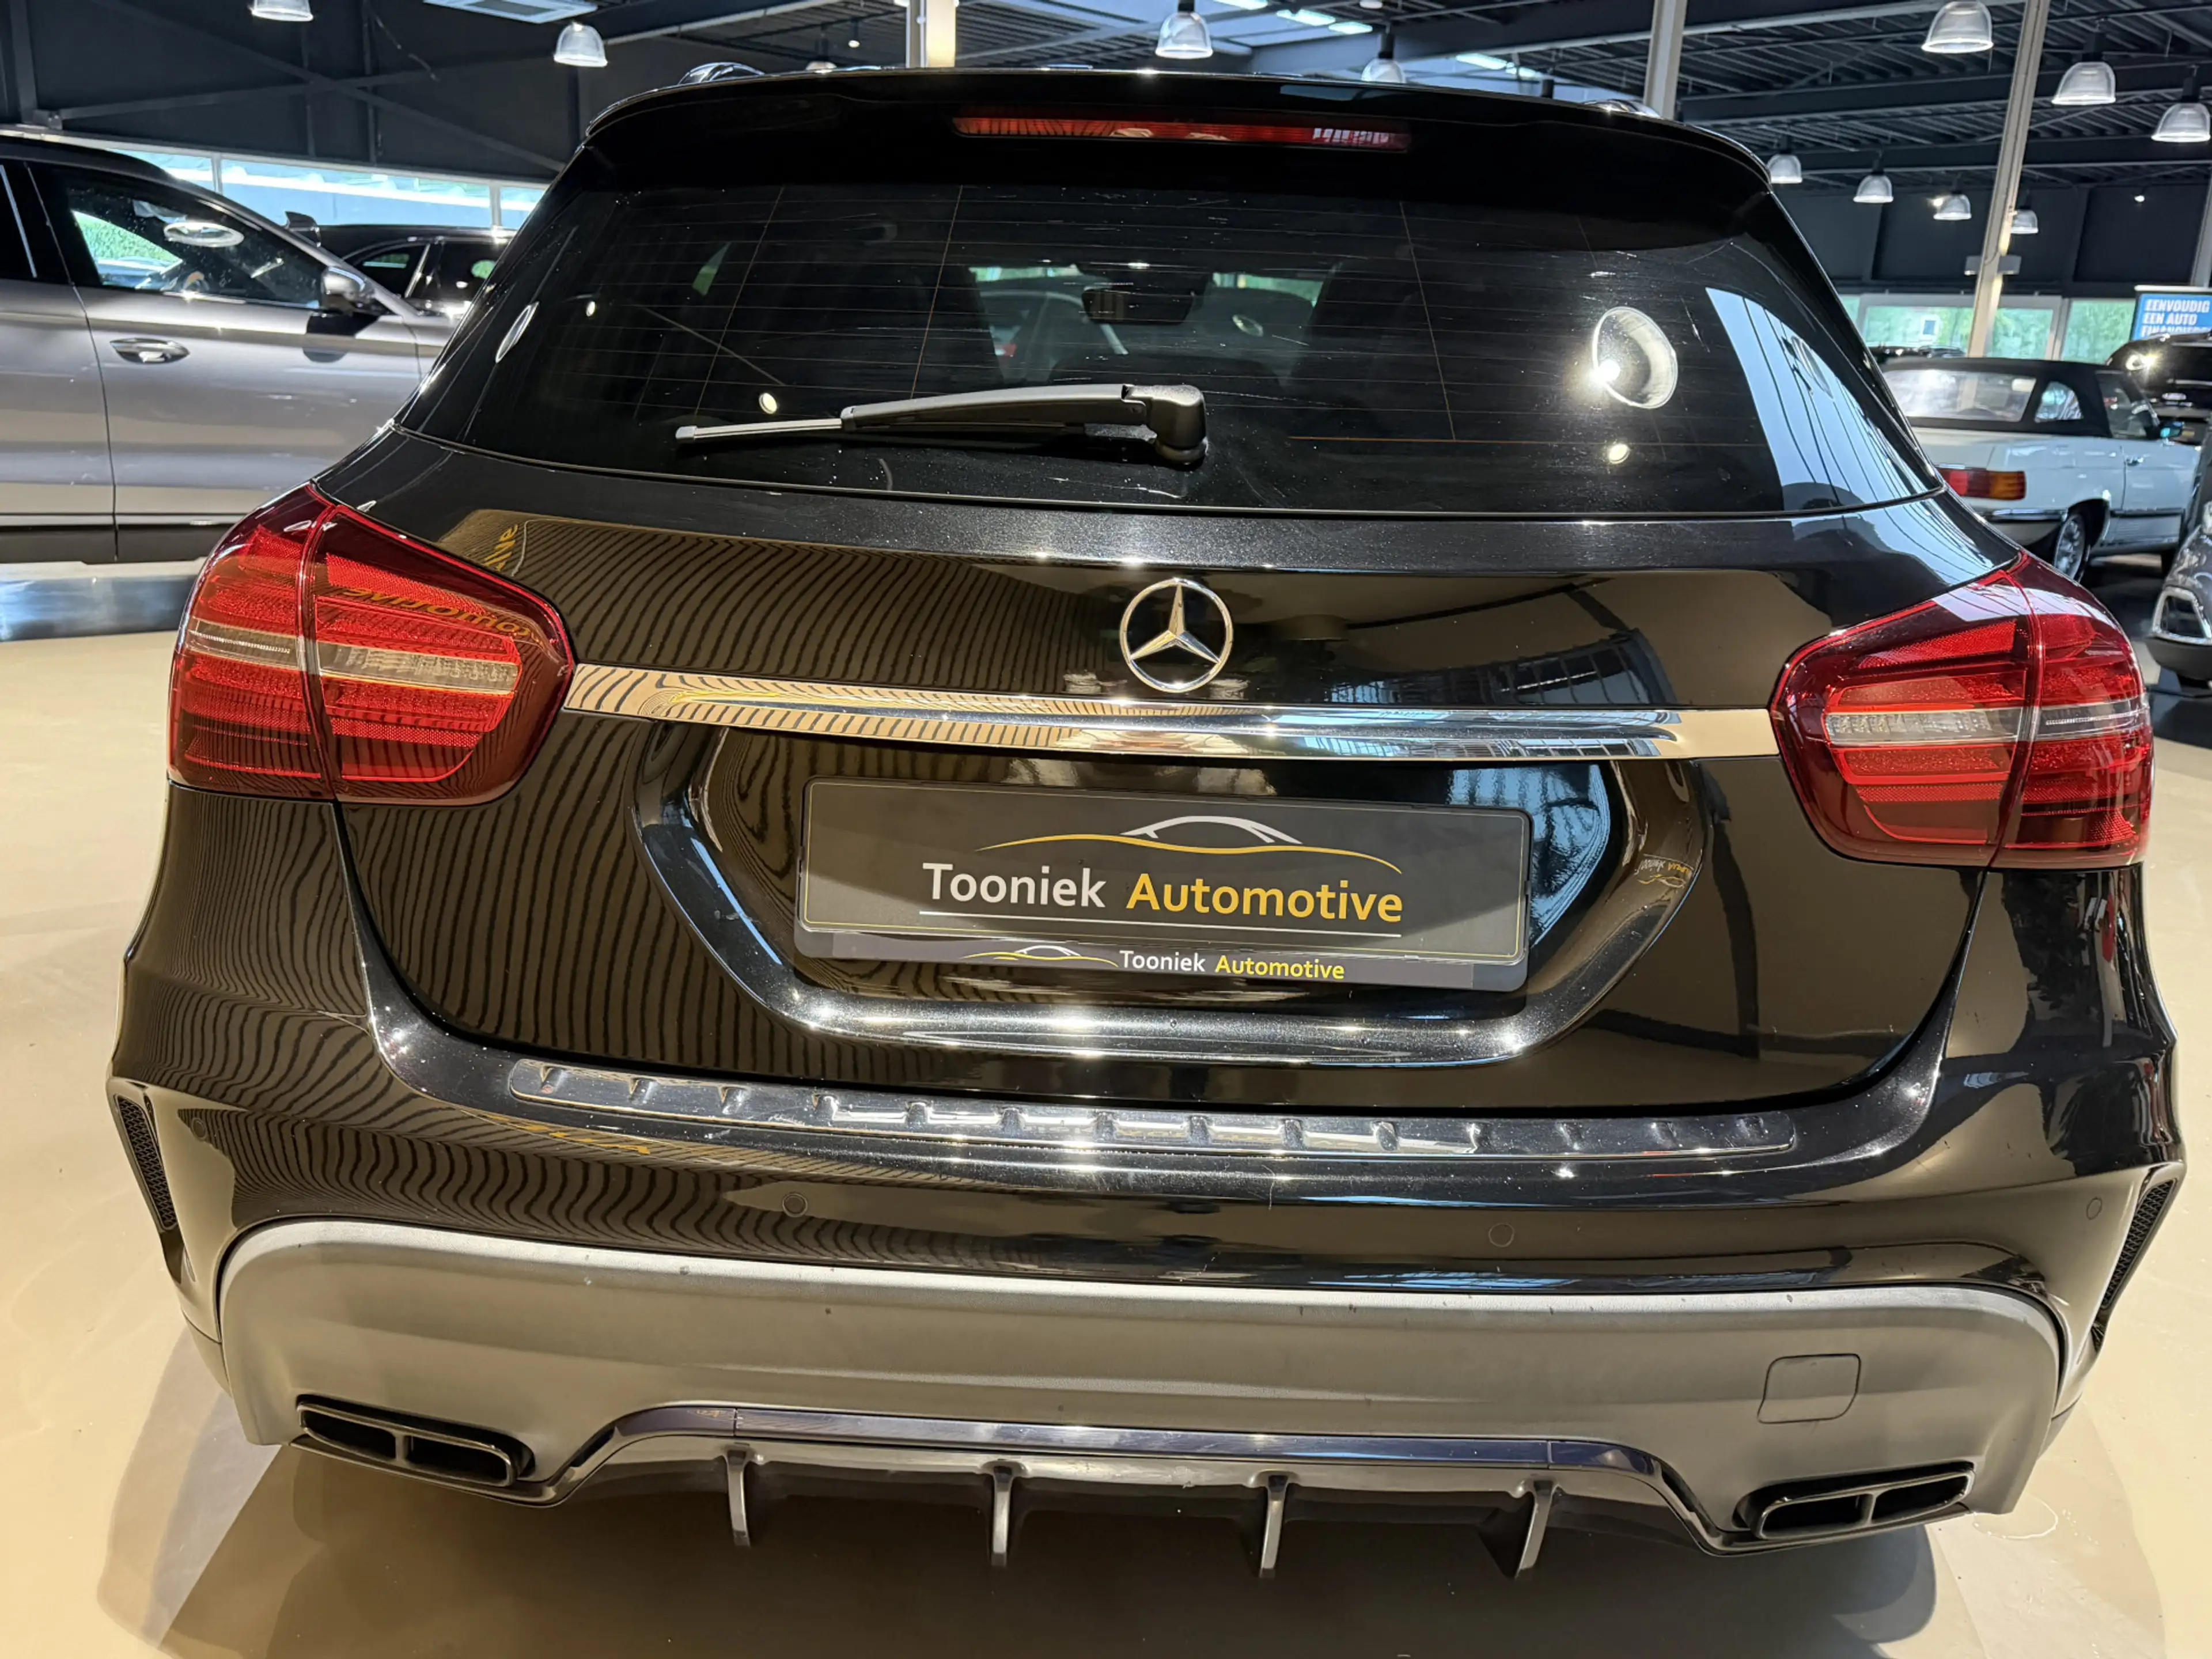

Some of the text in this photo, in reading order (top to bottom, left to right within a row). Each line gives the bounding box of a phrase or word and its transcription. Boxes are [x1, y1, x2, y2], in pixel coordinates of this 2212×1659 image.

[2145, 298, 2210, 313] EENVOUDIG
[2143, 312, 2198, 325] EEN AUTO
[922, 863, 1403, 922] Tooniek Automotive
[1119, 950, 1345, 979] Tooniek Automotive
